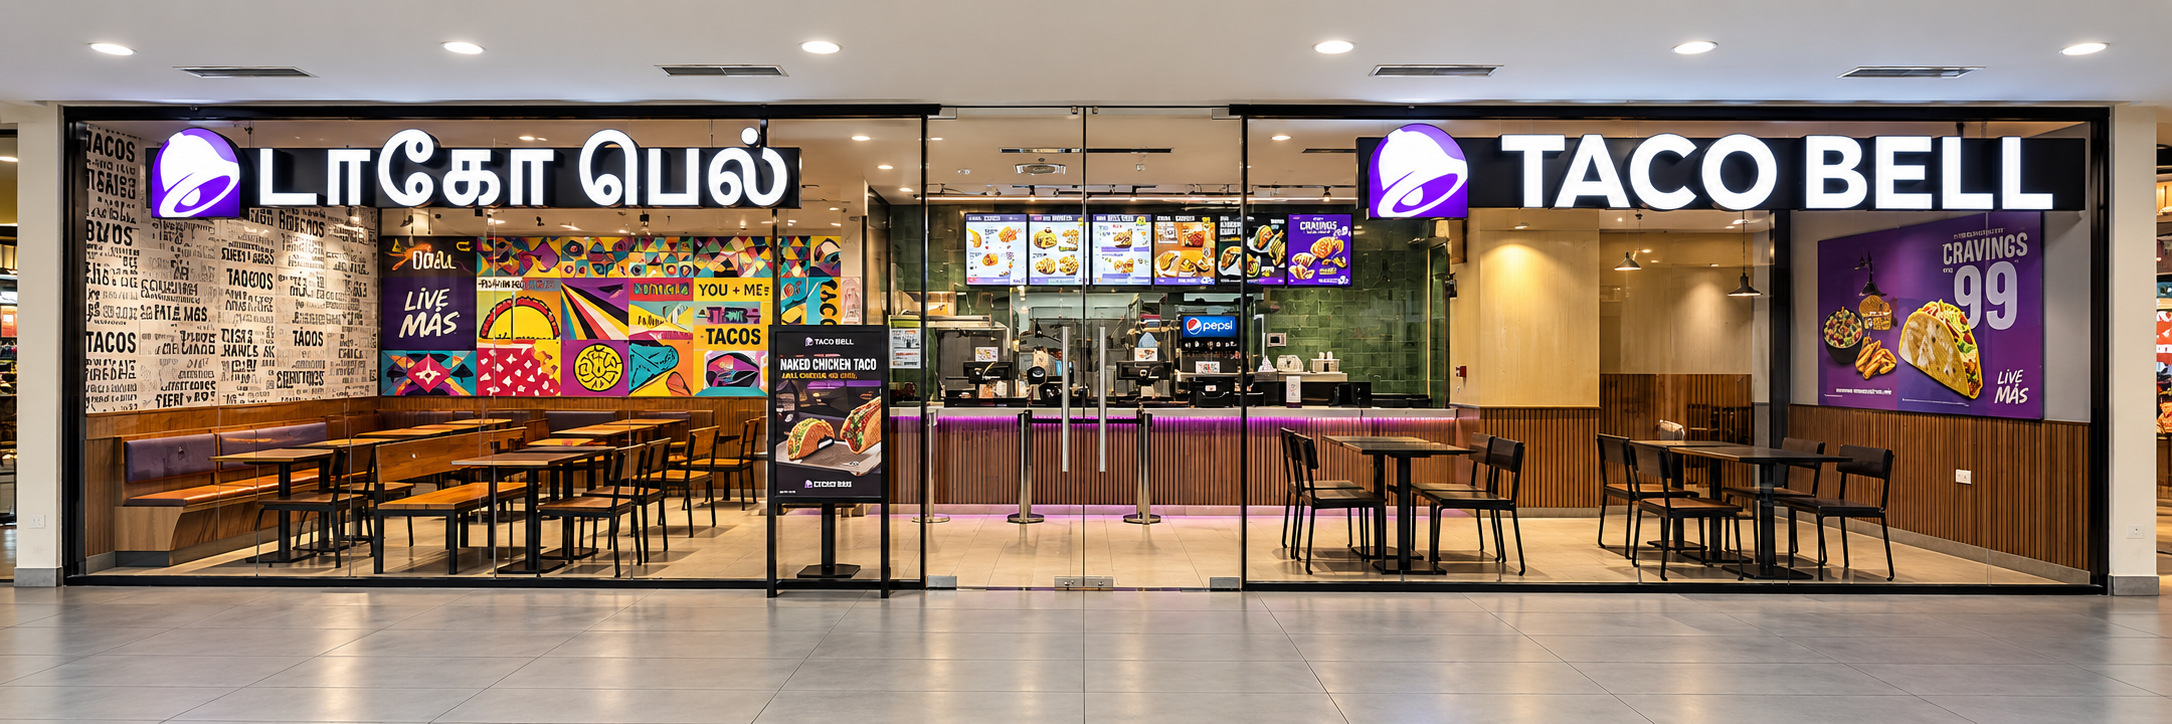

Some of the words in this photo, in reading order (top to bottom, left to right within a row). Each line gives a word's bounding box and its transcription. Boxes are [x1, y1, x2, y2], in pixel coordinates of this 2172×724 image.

[259, 129, 555, 207] டாகோ
[579, 127, 788, 207] பெல்
[1501, 133, 1778, 210] TACO
[1805, 136, 2054, 209] BELL
[1943, 232, 2028, 265] CRAVINGS
[404, 287, 450, 311] LIVE
[698, 284, 728, 297] YOU
[1954, 261, 2018, 330] 99
[398, 306, 461, 338] MÁS
[86, 331, 136, 353] TACOS
[705, 327, 761, 345] TACOS
[780, 358, 810, 371] NAKED
[812, 358, 851, 371] CHICKEN
[853, 358, 877, 371] TACO
[1997, 369, 2024, 385] LIVE
[1994, 383, 2029, 405] MÁS
